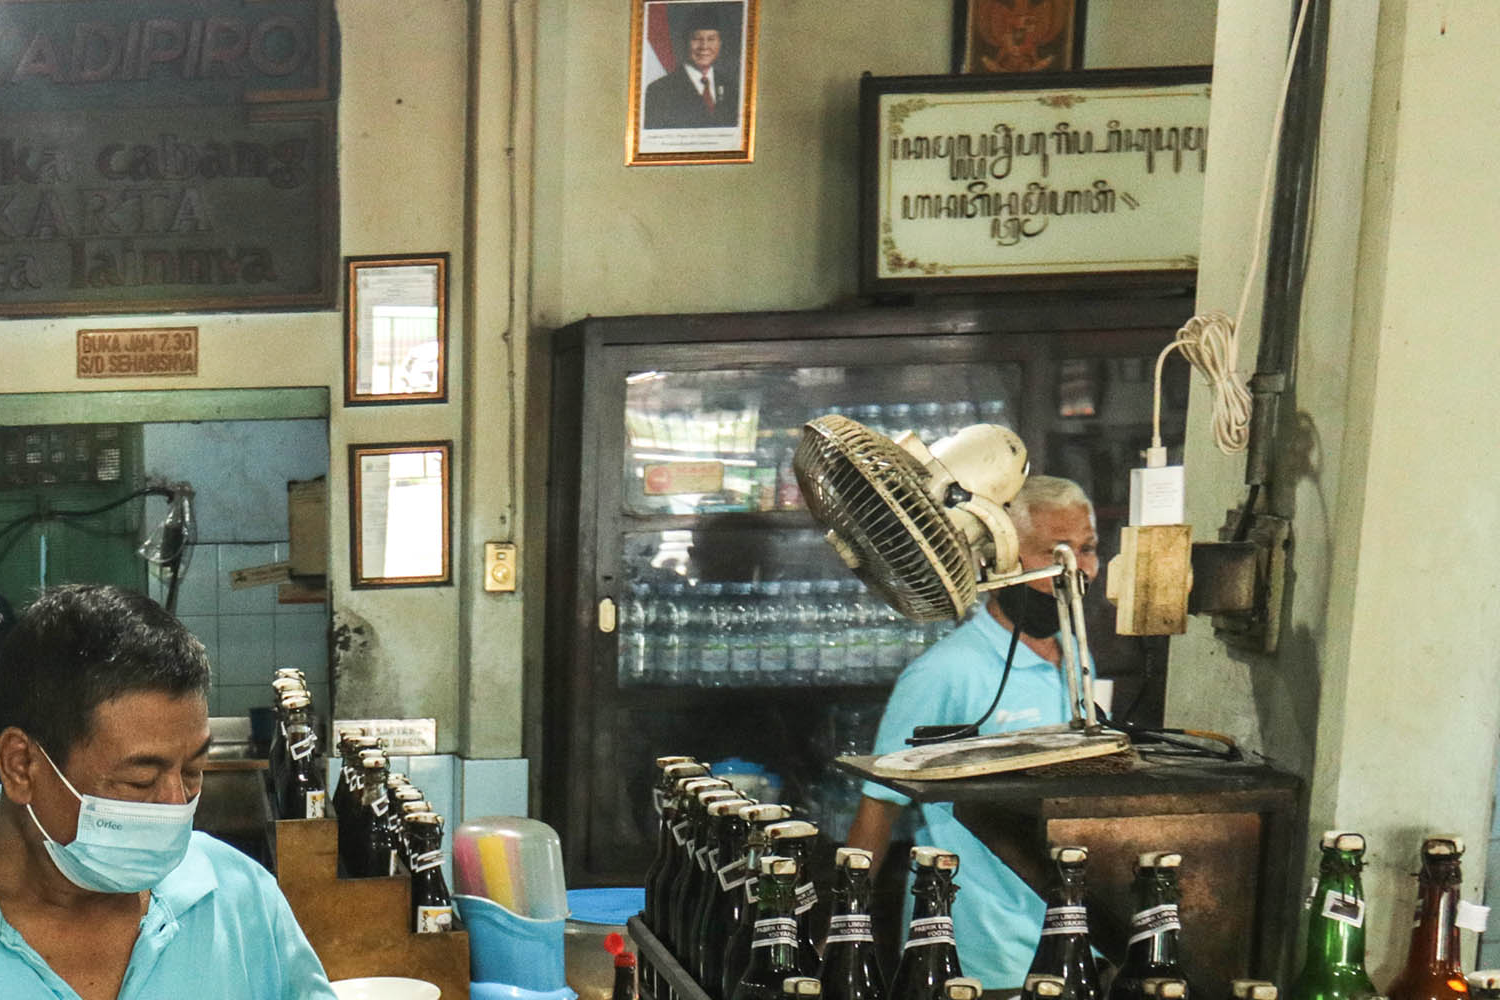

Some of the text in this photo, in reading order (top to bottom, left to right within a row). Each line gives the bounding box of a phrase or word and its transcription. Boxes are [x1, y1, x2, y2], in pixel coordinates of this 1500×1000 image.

[95, 131, 308, 190] cabang
[82, 334, 120, 353] BUKA
[124, 335, 154, 352] JAM
